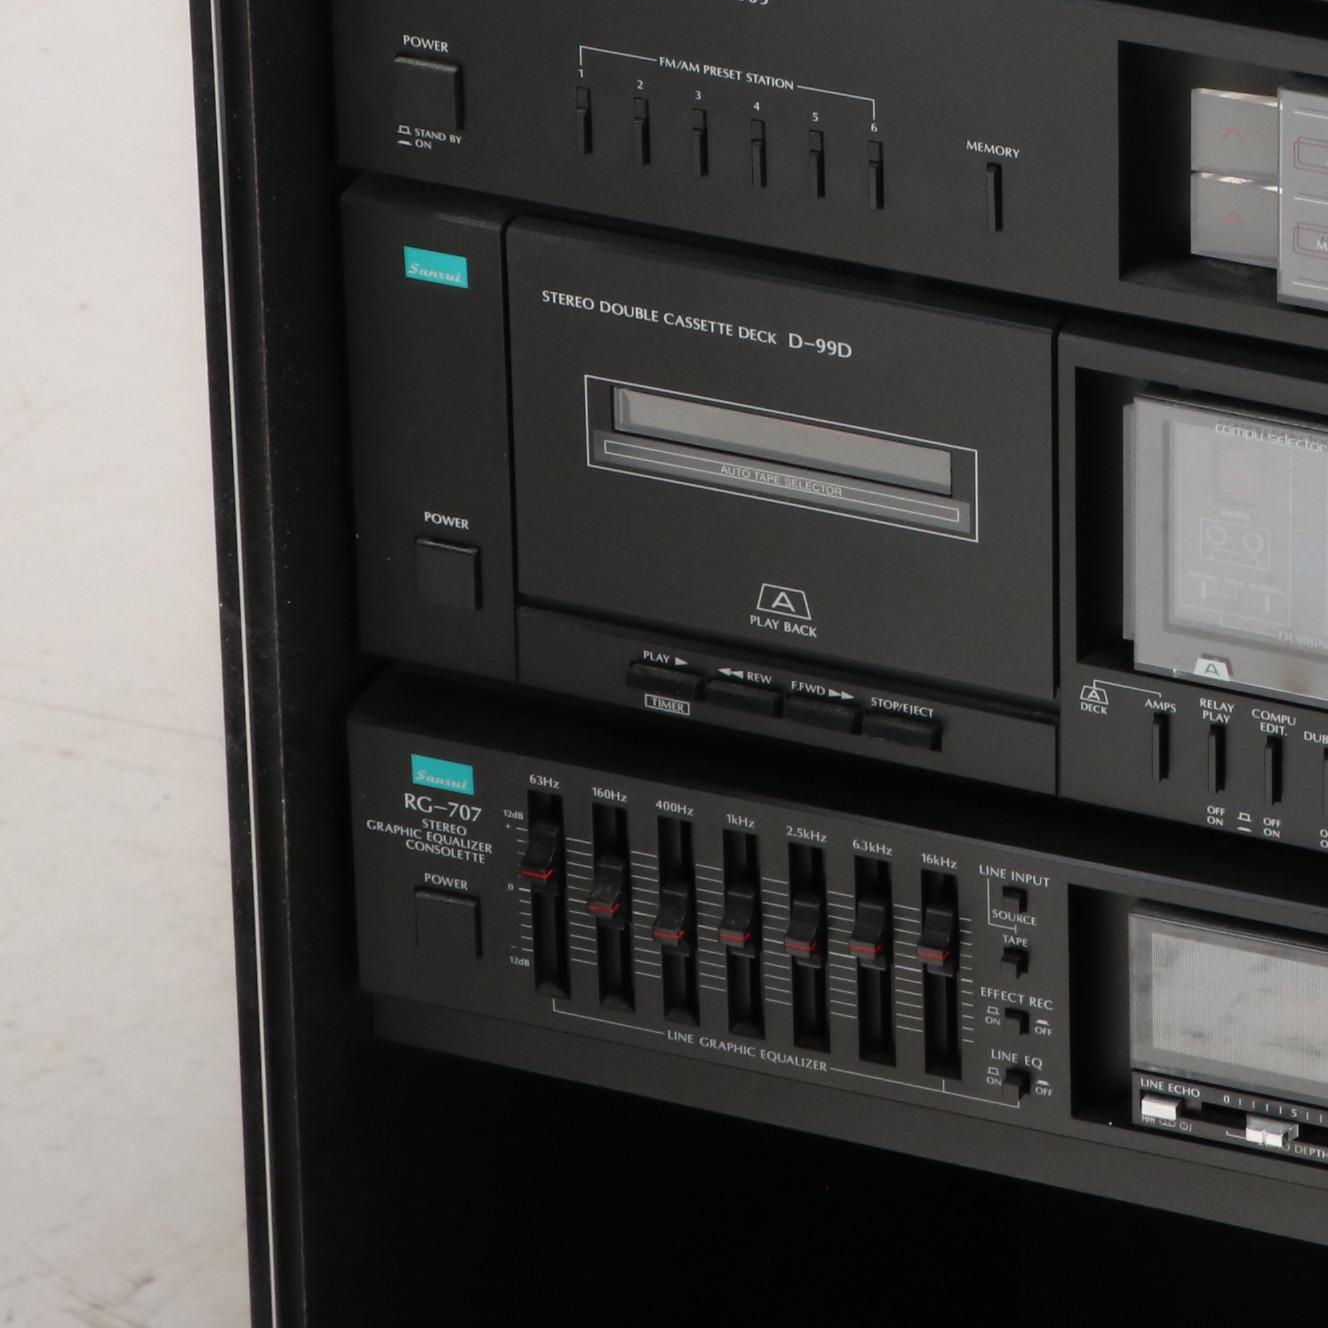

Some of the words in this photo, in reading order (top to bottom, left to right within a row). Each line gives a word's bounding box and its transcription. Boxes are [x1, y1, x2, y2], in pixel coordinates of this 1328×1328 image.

[403, 34, 448, 53] POWER
[659, 57, 700, 73] FM/AM
[703, 64, 743, 81] PRESET
[745, 71, 794, 90] STATION
[966, 140, 1020, 159] MEMORY
[409, 263, 463, 283] Sansui
[542, 290, 595, 311] STEREO
[599, 301, 659, 322] DOUBLE
[663, 312, 733, 337] CASSETTE
[738, 327, 777, 345] DECK
[789, 332, 852, 359] D-99D
[424, 511, 469, 530] POWER
[750, 615, 779, 631] PLAY
[784, 622, 817, 638] BACK
[643, 650, 670, 664] PLAY
[747, 671, 772, 685] REW
[871, 697, 934, 718] STOP/EJECT
[1080, 701, 1107, 715] DECK
[1145, 699, 1177, 713] AMPS
[1200, 698, 1234, 713] RELAY
[1202, 710, 1231, 724] PLAY
[1251, 708, 1296, 726] COMPU
[415, 769, 468, 790] Sansui
[529, 774, 560, 790] 63Hz
[592, 787, 628, 803] 160Hz
[404, 793, 482, 822] RG-707
[656, 800, 694, 817] 400Hz
[422, 819, 467, 836] STEREO
[726, 814, 755, 830] 1kHz
[367, 819, 422, 840] GRAPHIC
[426, 831, 493, 854] EQUALIZER
[786, 826, 827, 844] 2.5kHz
[406, 838, 486, 864] CONSOLETTE
[921, 853, 958, 870] 16kHz
[424, 872, 468, 891] POWER
[978, 864, 1012, 881] LINE
[1011, 871, 1050, 887] INPUT
[980, 987, 1025, 1006] EFFECT
[1028, 996, 1053, 1011] REC
[667, 1029, 695, 1045] LINE
[699, 1035, 756, 1058] GRAPHIC
[760, 1047, 827, 1072] EQUALIZER
[990, 1048, 1018, 1064] LINE
[1024, 1054, 1042, 1070] EQ
